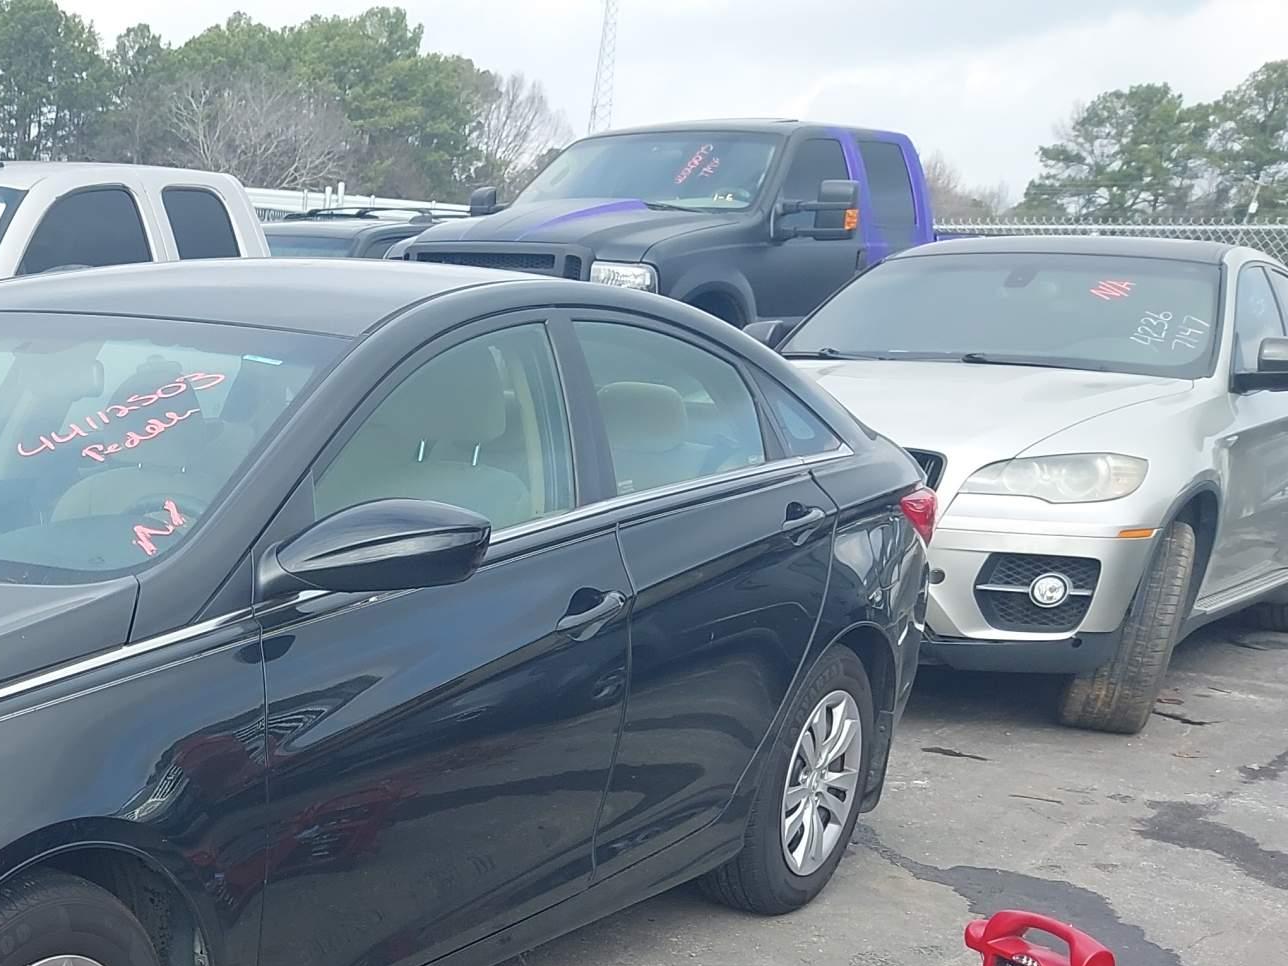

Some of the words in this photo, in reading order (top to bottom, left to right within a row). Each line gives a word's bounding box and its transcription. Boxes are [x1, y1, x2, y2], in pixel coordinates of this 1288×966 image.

[1129, 311, 1173, 345] 4236
[1171, 315, 1211, 350] 7147
[17, 372, 225, 456] 44112503
